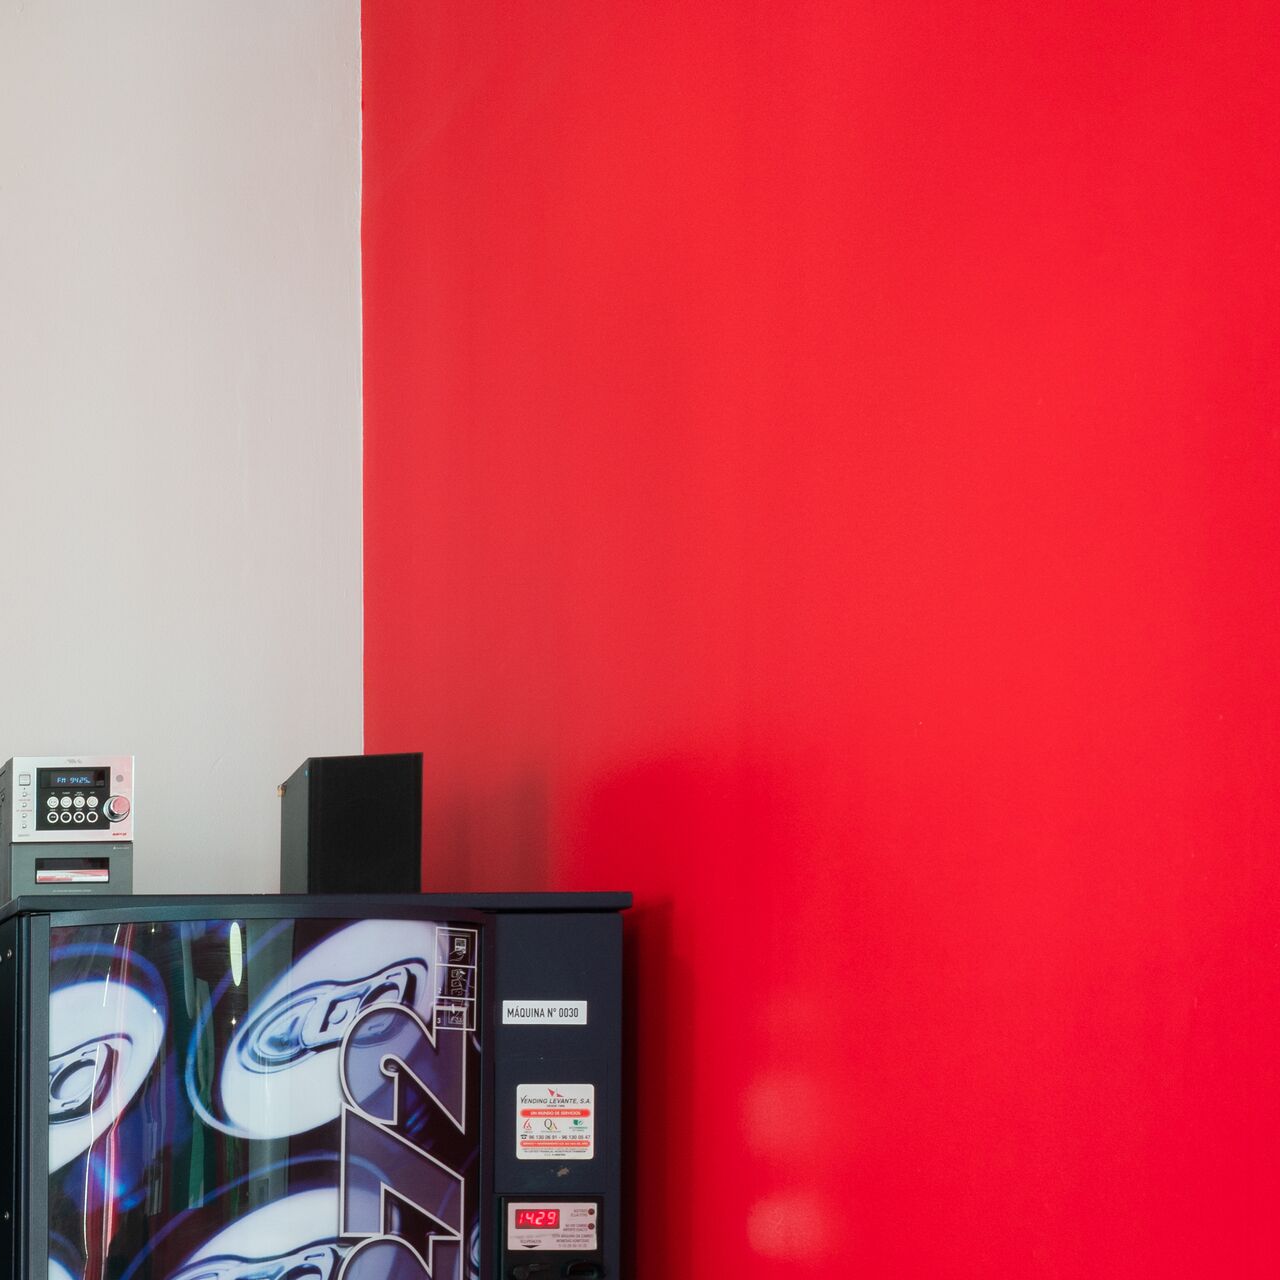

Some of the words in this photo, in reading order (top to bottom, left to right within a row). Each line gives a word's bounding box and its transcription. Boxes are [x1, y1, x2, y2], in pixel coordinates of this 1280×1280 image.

[507, 1005, 546, 1019] MÁQUINA
[558, 1008, 579, 1019] 0030
[521, 1095, 548, 1104] VENDING
